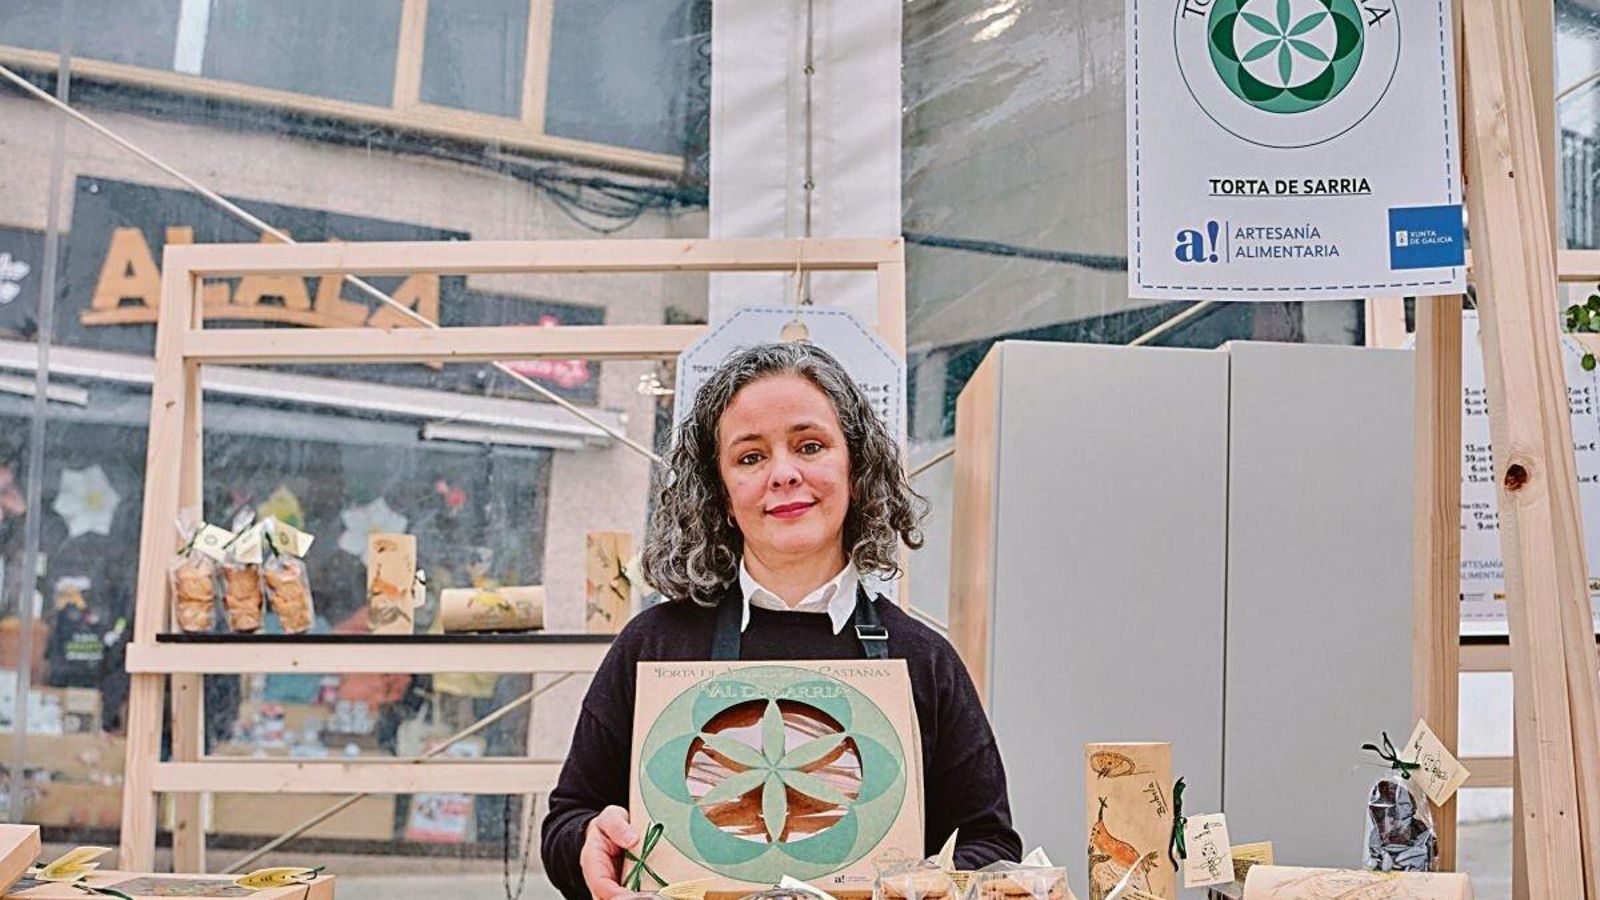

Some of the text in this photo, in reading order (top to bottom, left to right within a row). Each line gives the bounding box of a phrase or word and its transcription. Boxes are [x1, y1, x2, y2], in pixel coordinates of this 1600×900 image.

[1209, 178, 1372, 194] TORTA DE SARRIA
[1175, 220, 1321, 263] a! ARTESANÍA
[1421, 236, 1454, 245] GALICIA
[1235, 245, 1340, 259] ALIMENTARIA
